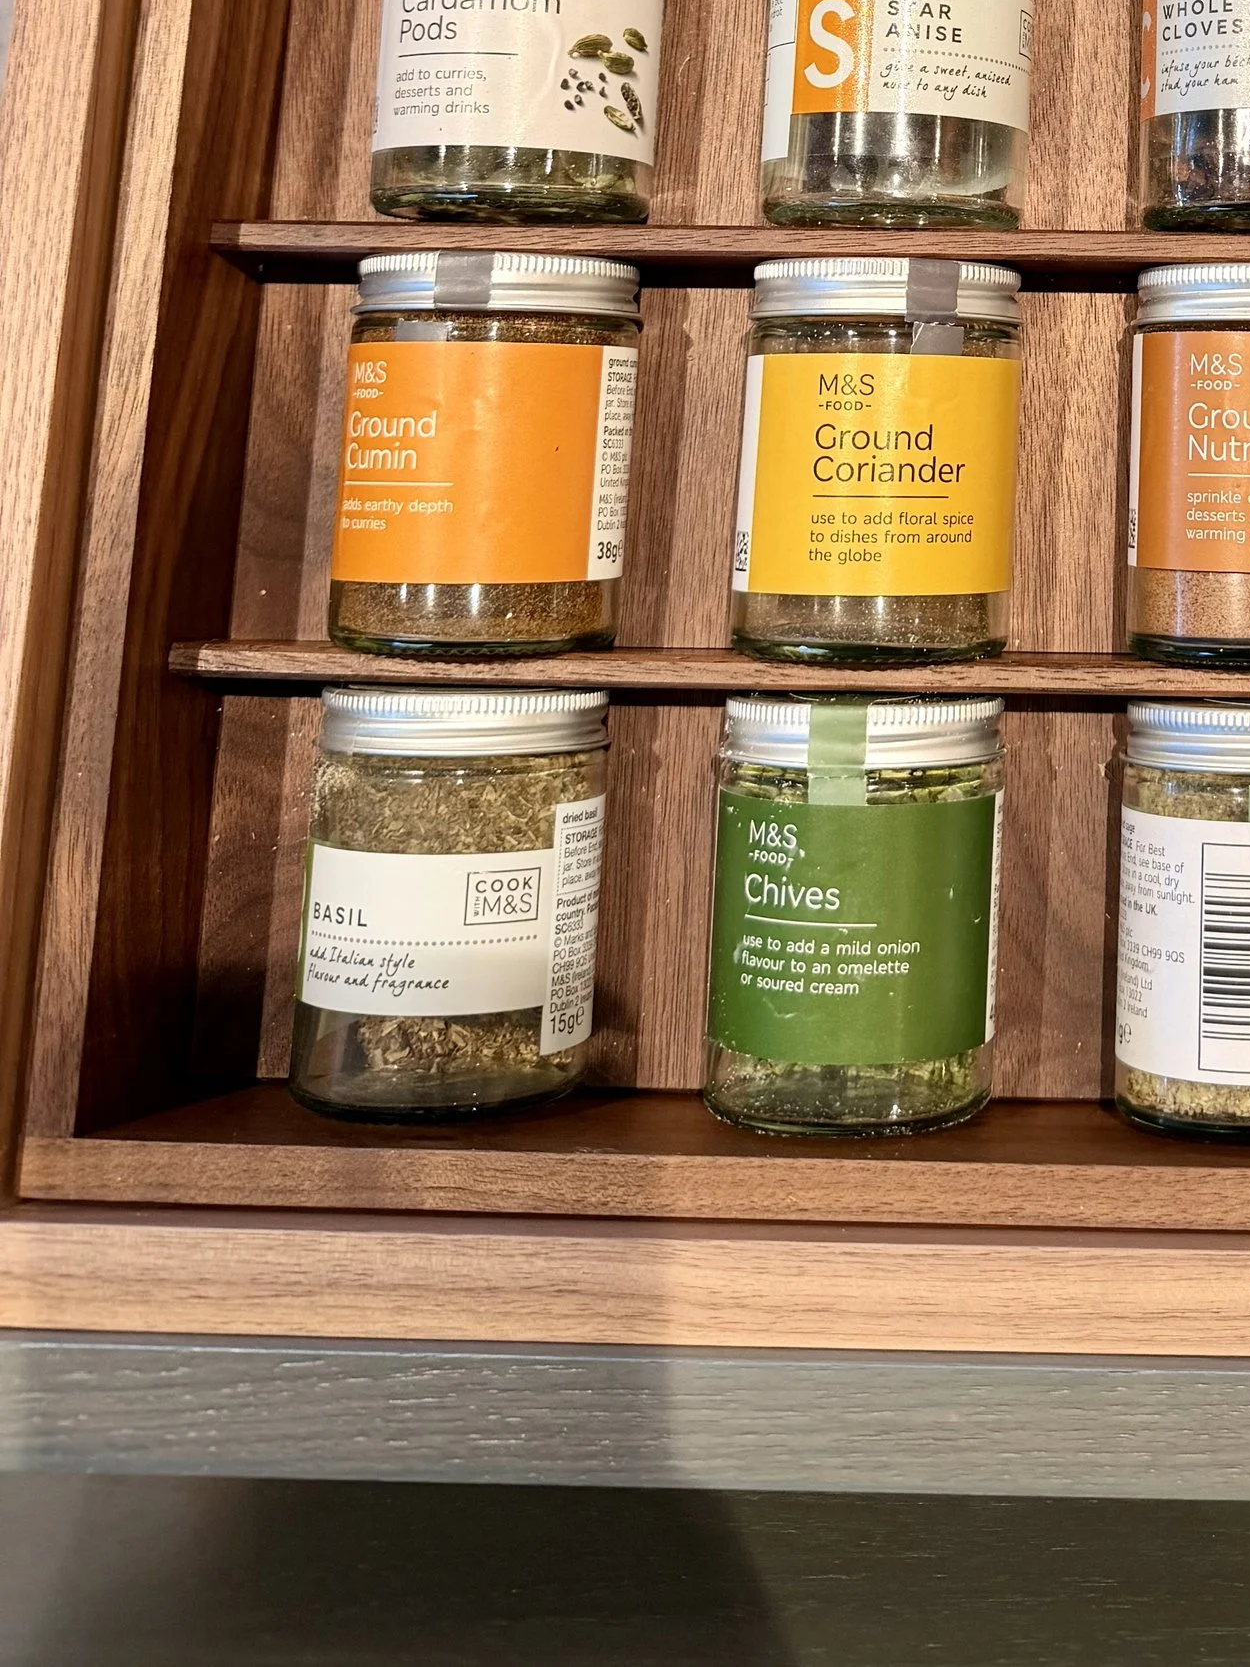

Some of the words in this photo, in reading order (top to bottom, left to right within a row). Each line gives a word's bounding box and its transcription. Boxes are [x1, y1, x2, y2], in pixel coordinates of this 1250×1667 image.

[887, 0, 952, 21] SAR
[400, 15, 457, 43] Pods
[1162, 18, 1243, 42] CLOVES
[916, 79, 929, 90] to
[935, 83, 958, 100] any
[962, 83, 987, 97] dish
[1161, 80, 1181, 92] stud
[1180, 79, 1209, 96] your
[1213, 75, 1238, 86] ham
[354, 360, 388, 384] M&S
[1190, 353, 1243, 376] M&S
[819, 374, 874, 395] M&S
[350, 410, 437, 438] Ground
[815, 424, 933, 451] Ground
[348, 442, 417, 470] Cumin
[813, 455, 965, 483] Coriander
[749, 820, 798, 849] M&S
[476, 876, 533, 893] COOK
[744, 873, 840, 910] Chives
[482, 893, 532, 916] M&S
[1156, 890, 1196, 904] sunlight.
[313, 901, 367, 927] BASIL
[740, 972, 752, 985] or
[756, 975, 804, 993] soured
[810, 982, 859, 995] cream
